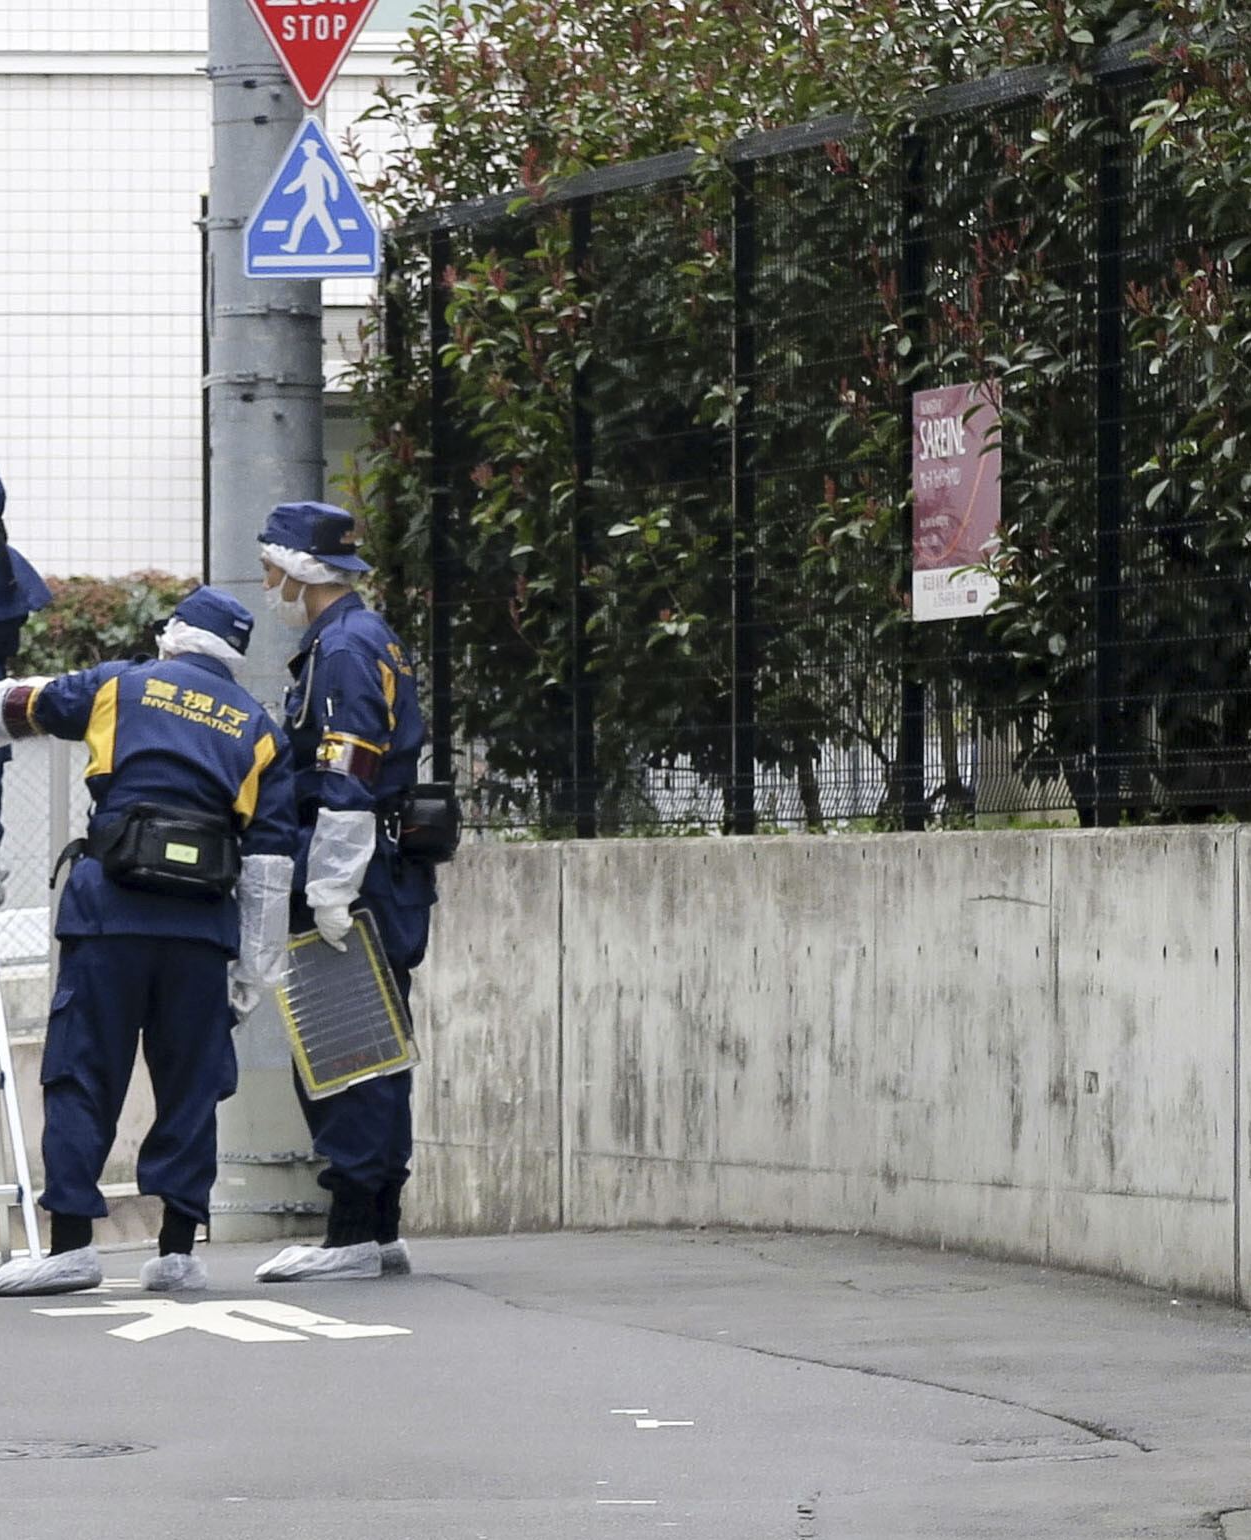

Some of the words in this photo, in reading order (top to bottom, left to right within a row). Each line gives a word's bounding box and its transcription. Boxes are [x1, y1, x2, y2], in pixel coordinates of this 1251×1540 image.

[282, 14, 348, 41] STOP
[141, 696, 245, 739] INVESTIGATION
[144, 677, 250, 726] 警視庁
